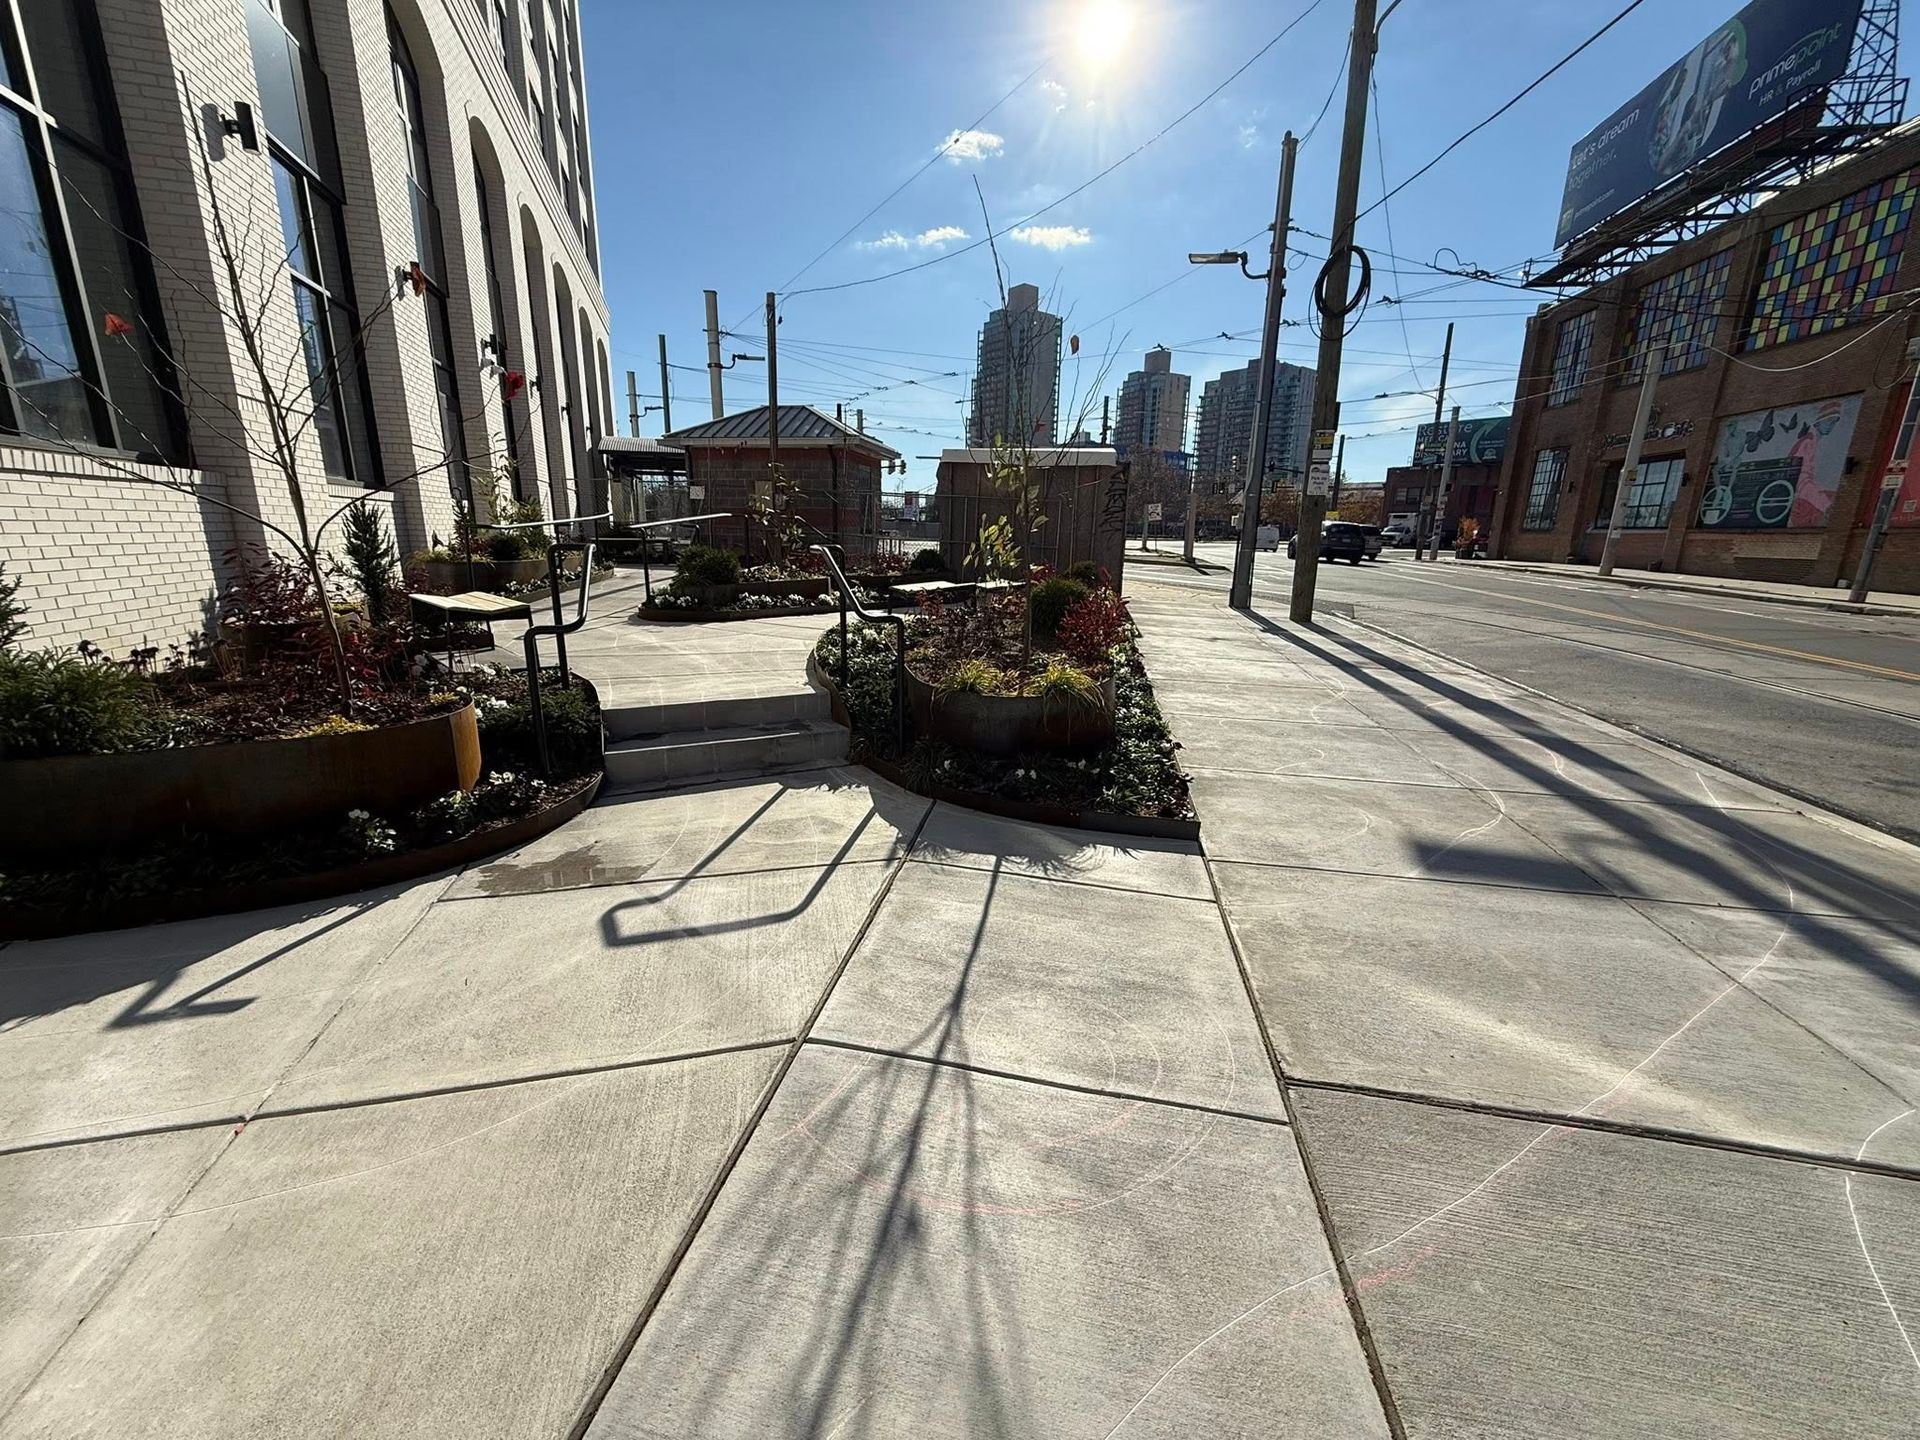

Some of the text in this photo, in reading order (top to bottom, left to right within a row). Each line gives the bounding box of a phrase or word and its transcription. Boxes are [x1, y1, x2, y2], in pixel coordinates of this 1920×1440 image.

[1749, 22, 1842, 100] primepoint
[1759, 89, 1774, 107] HR
[1786, 59, 1822, 89] Payroll
[1598, 108, 1640, 149] dream
[1418, 423, 1473, 437] Restre
